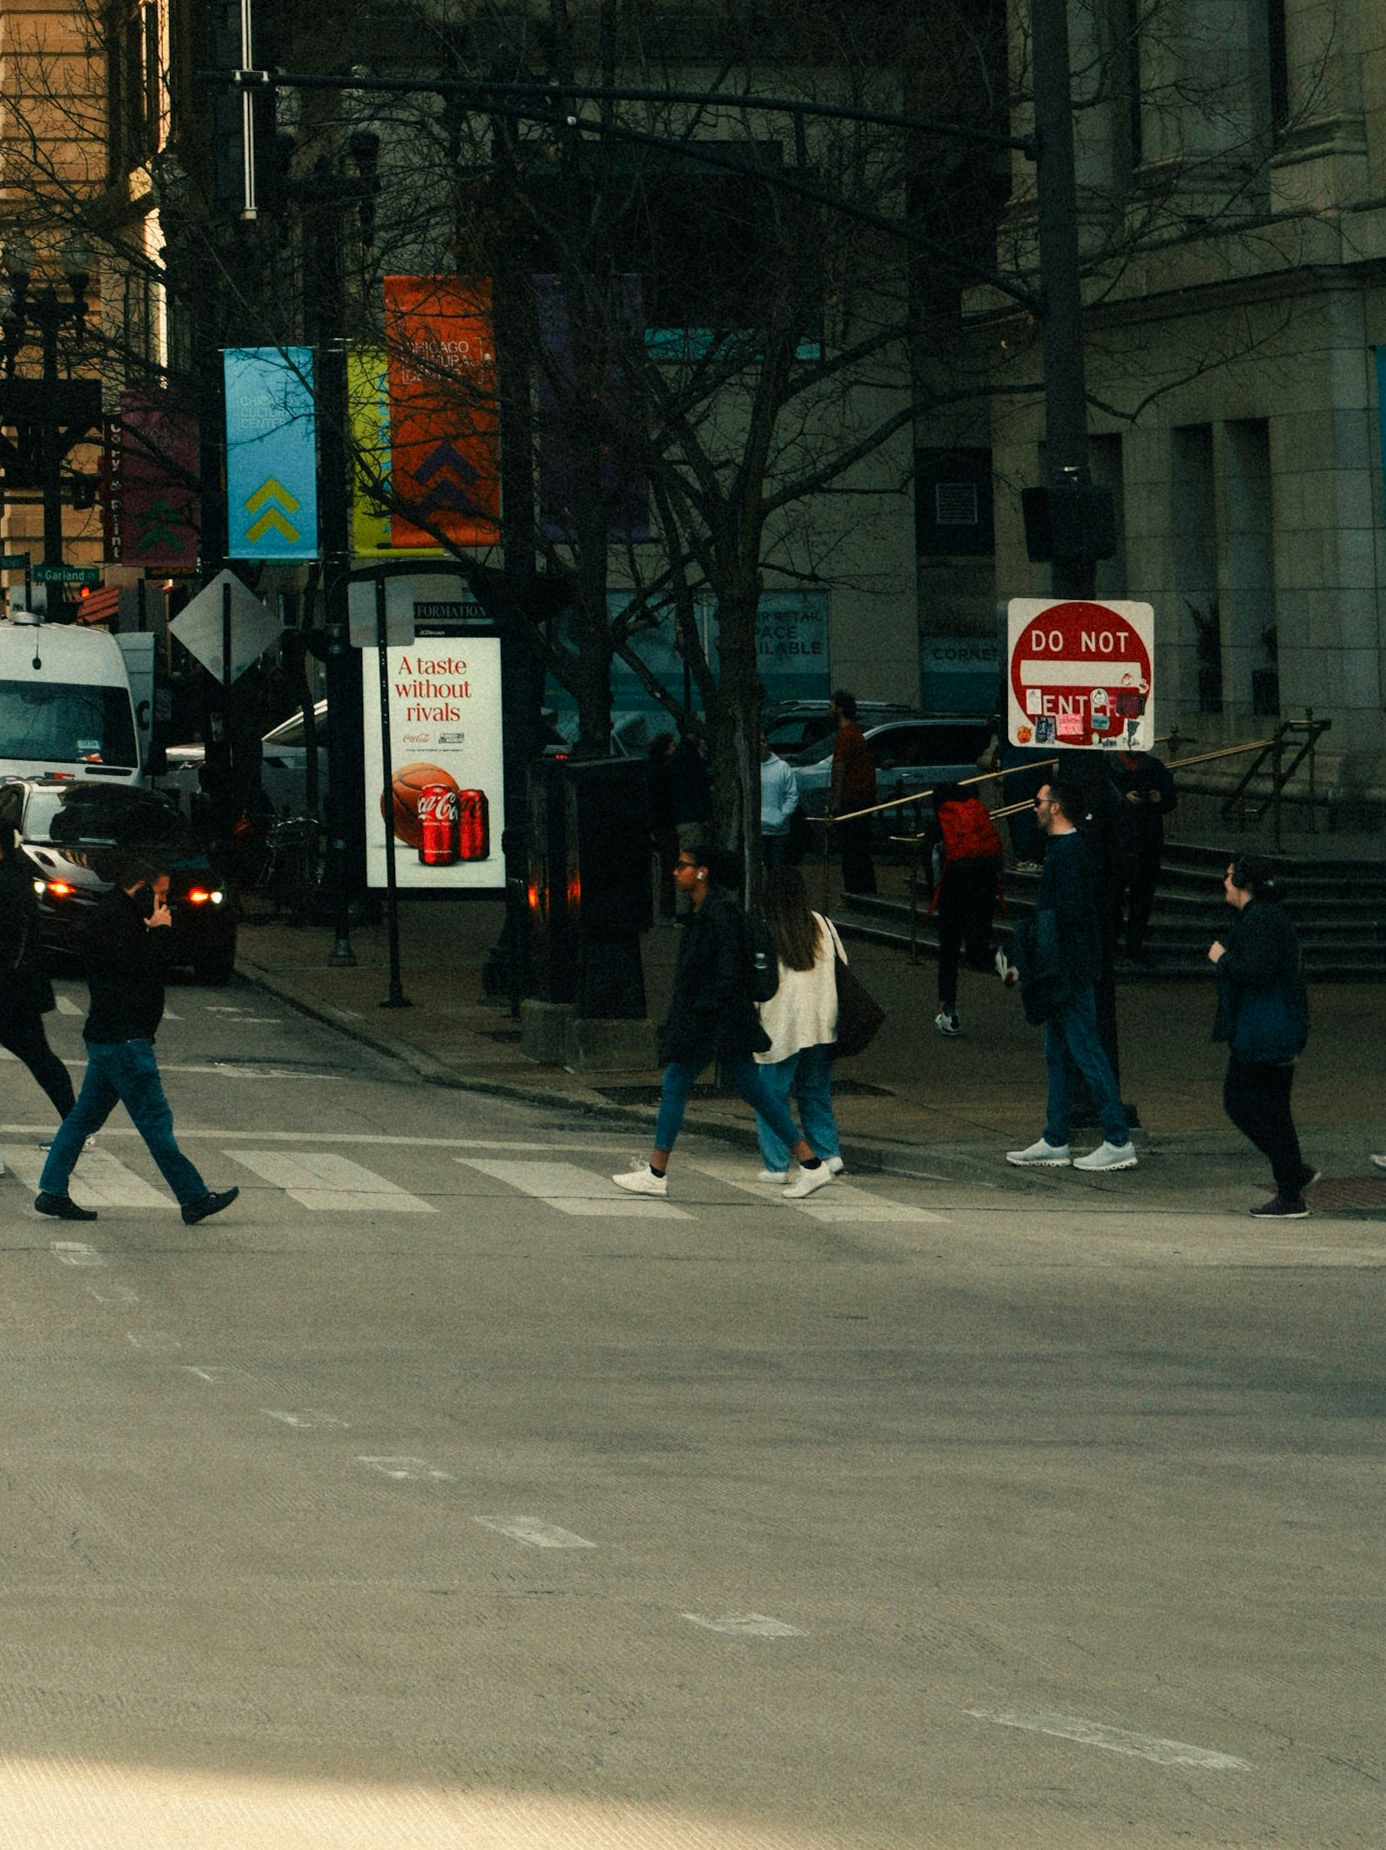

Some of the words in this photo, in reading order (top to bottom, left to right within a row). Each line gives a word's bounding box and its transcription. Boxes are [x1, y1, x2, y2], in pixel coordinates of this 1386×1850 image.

[45, 570, 85, 581] Garland
[416, 604, 486, 617] FORMATION
[754, 626, 798, 640] PACE
[755, 642, 822, 655] ILABLE
[1031, 630, 1064, 653] DO
[1081, 631, 1129, 653] NOT
[398, 656, 412, 675] A
[417, 656, 467, 675] taste
[395, 680, 472, 698] without
[407, 703, 460, 722] rivals
